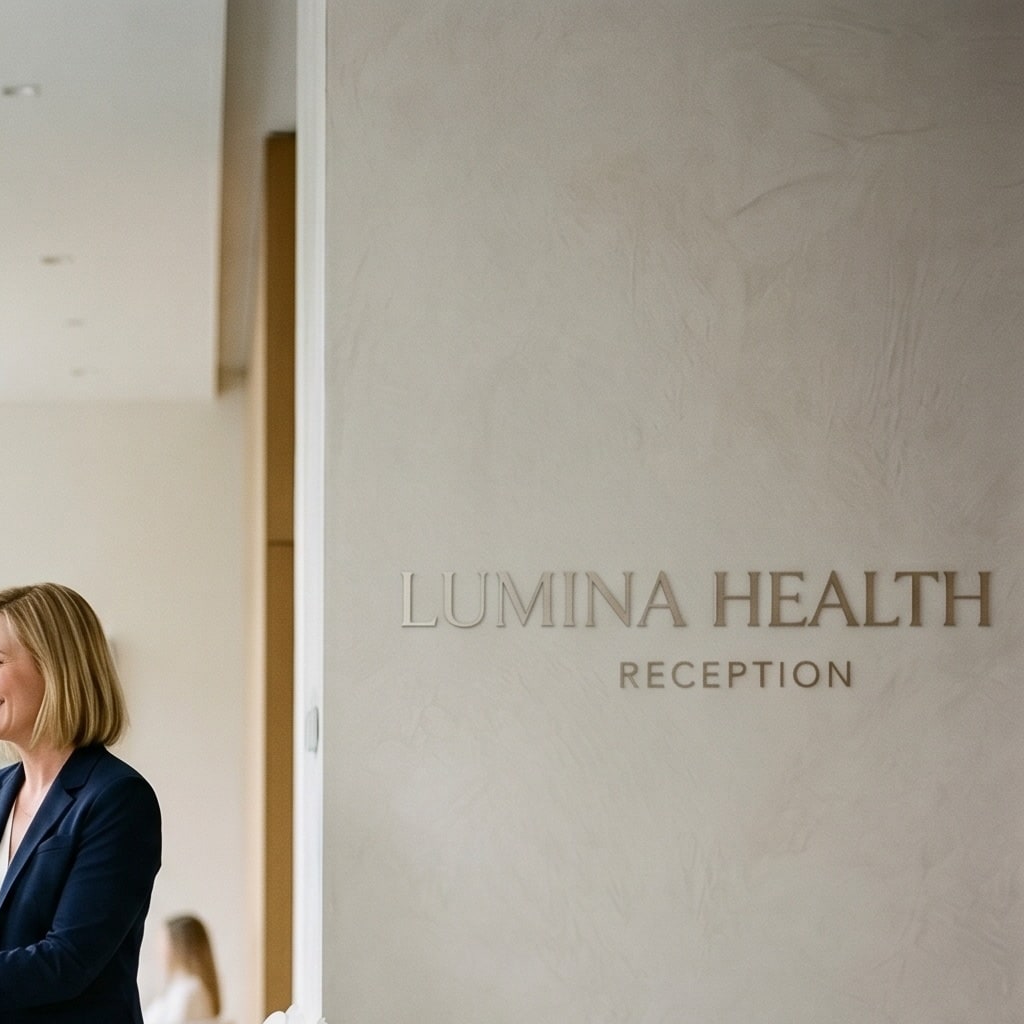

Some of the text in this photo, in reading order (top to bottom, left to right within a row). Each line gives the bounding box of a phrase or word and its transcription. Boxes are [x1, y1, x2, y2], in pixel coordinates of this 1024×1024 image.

[400, 570, 992, 628] LUMINA HEALTH
[619, 661, 852, 689] RECEPTION
